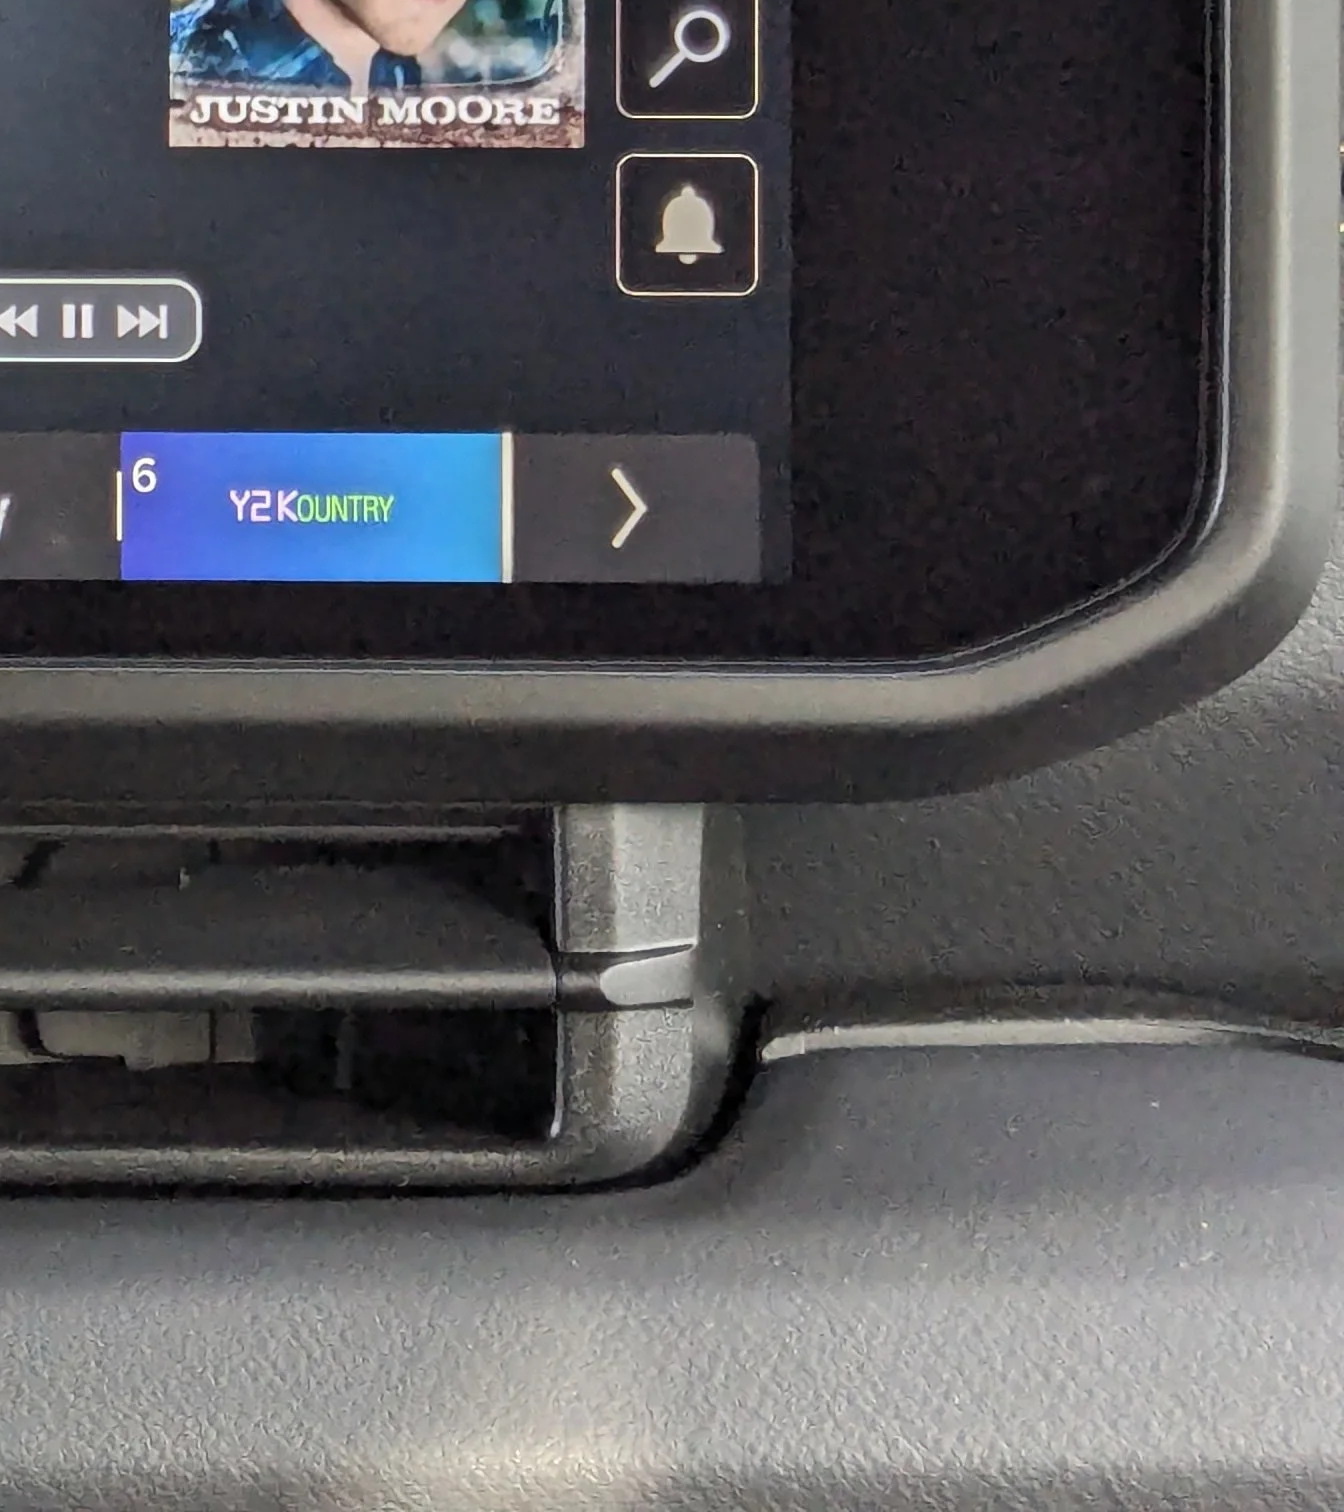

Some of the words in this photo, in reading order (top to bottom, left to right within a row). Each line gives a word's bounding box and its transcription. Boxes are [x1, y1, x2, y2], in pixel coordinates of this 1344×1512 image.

[188, 95, 368, 126] JUSTIN
[379, 95, 561, 127] MOORE
[131, 458, 157, 494] 6
